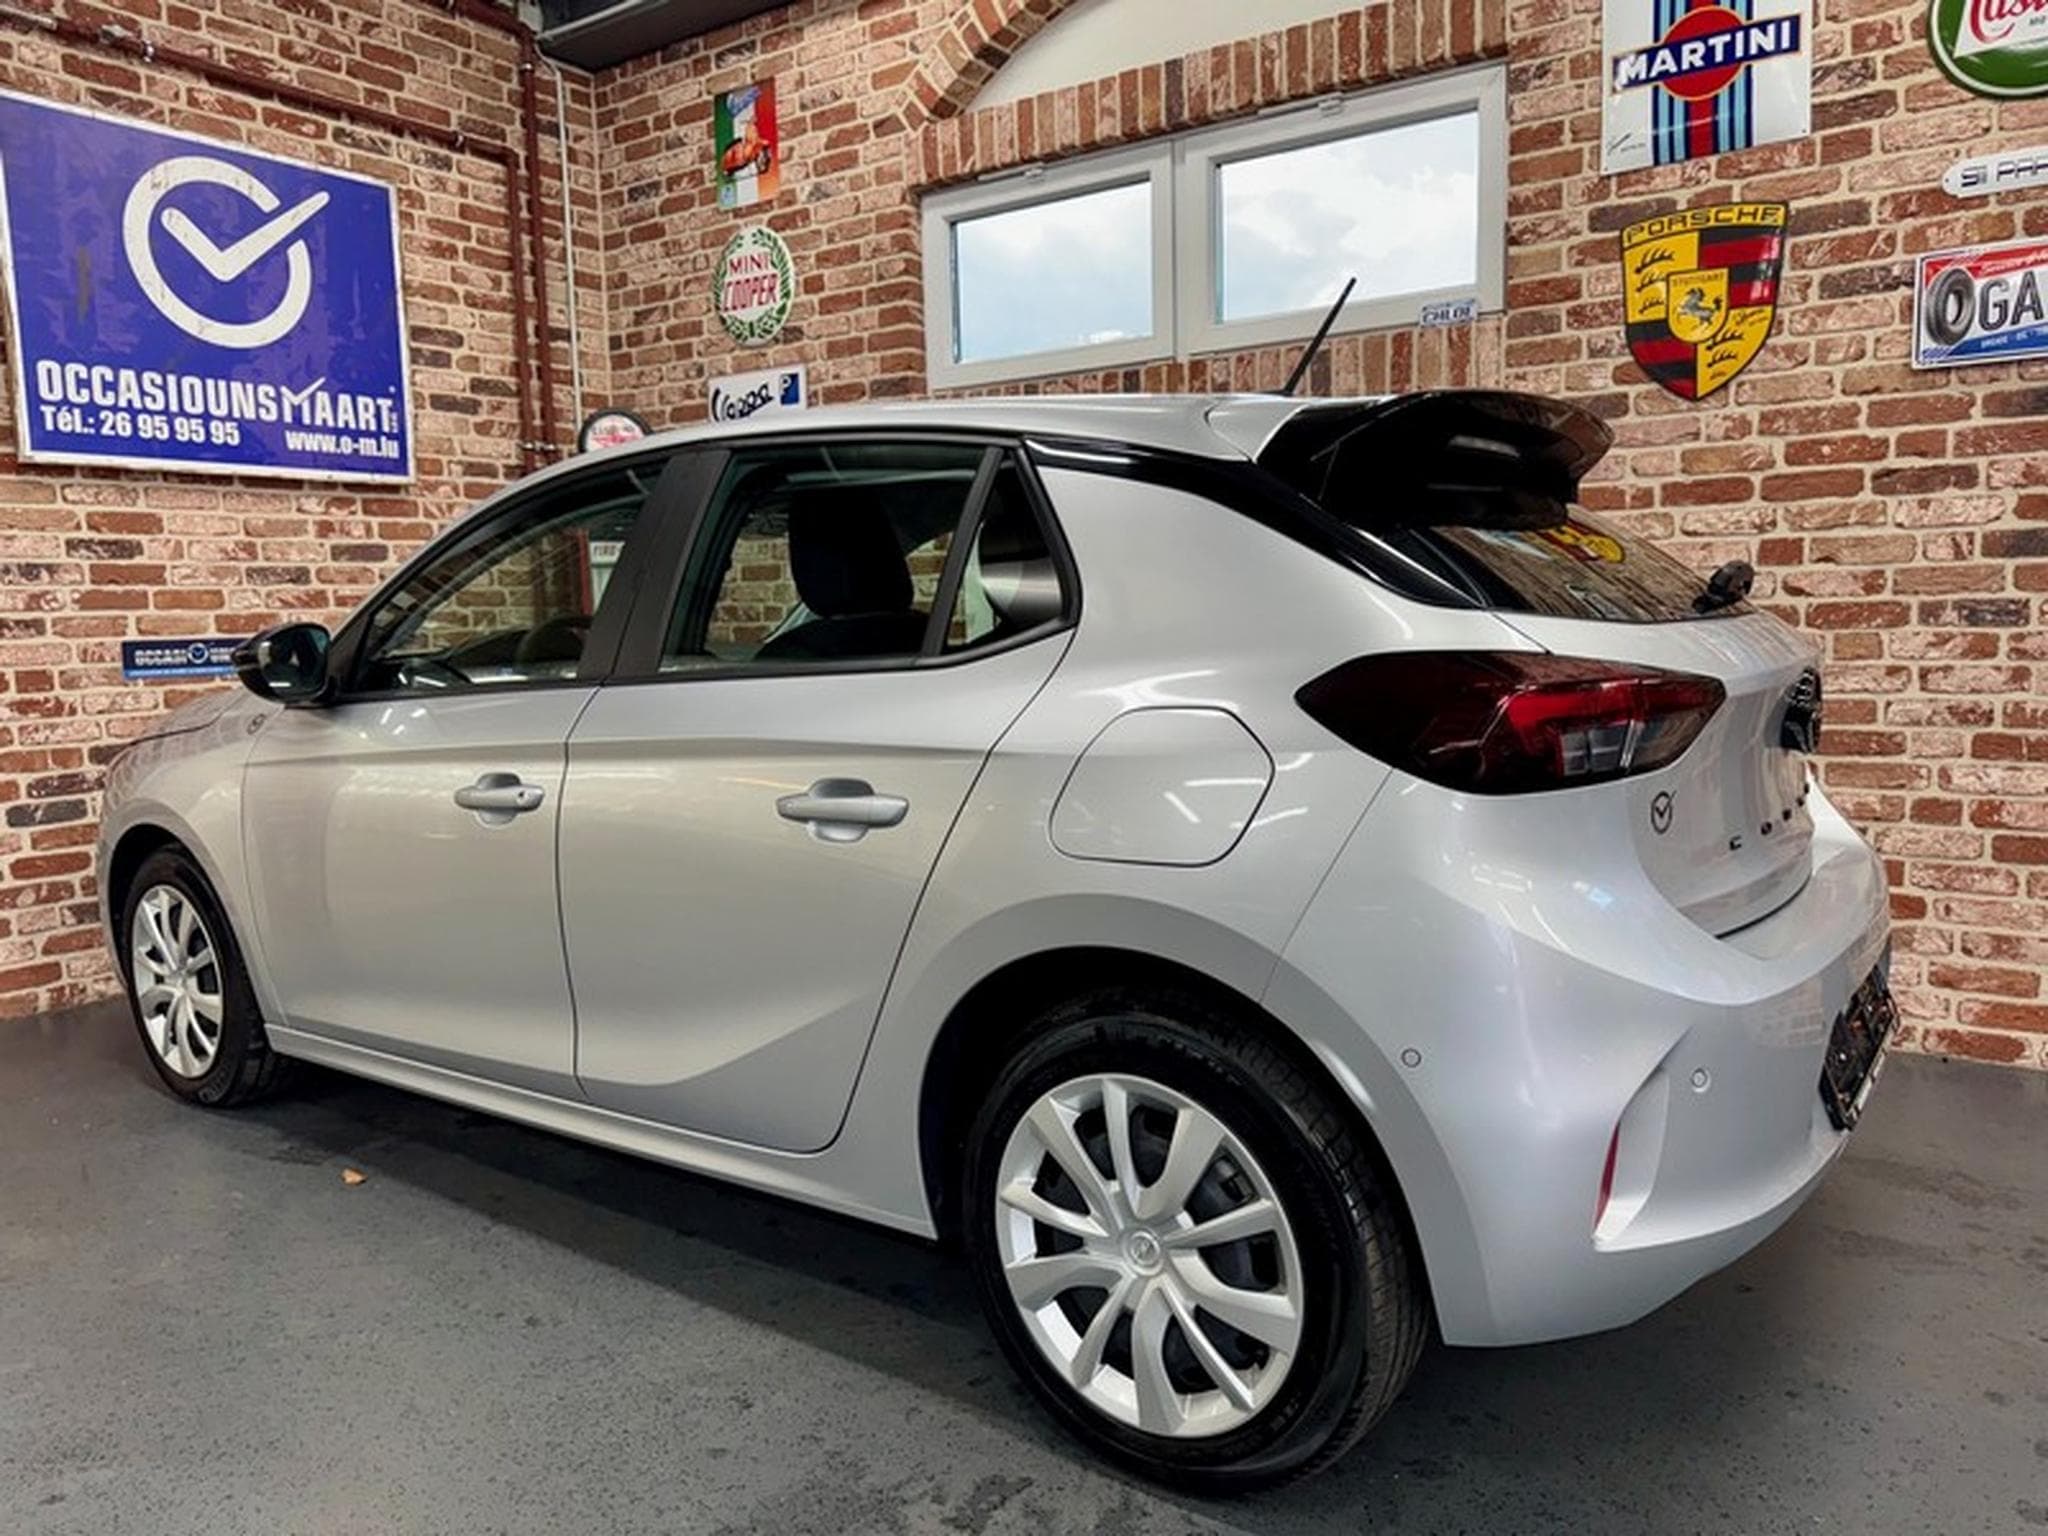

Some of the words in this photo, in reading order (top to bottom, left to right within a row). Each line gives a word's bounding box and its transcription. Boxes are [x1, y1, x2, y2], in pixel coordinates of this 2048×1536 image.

[1617, 20, 1791, 89] MARTINI
[1627, 206, 1781, 244] PORSCHE
[728, 252, 769, 275] MINI
[723, 273, 778, 312] COOPER
[40, 404, 96, 435] Tél.:
[100, 410, 133, 437] 26
[137, 413, 170, 441] 95
[174, 416, 206, 444] 95
[210, 420, 241, 447] 95
[285, 430, 399, 459] www.o-m.lu
